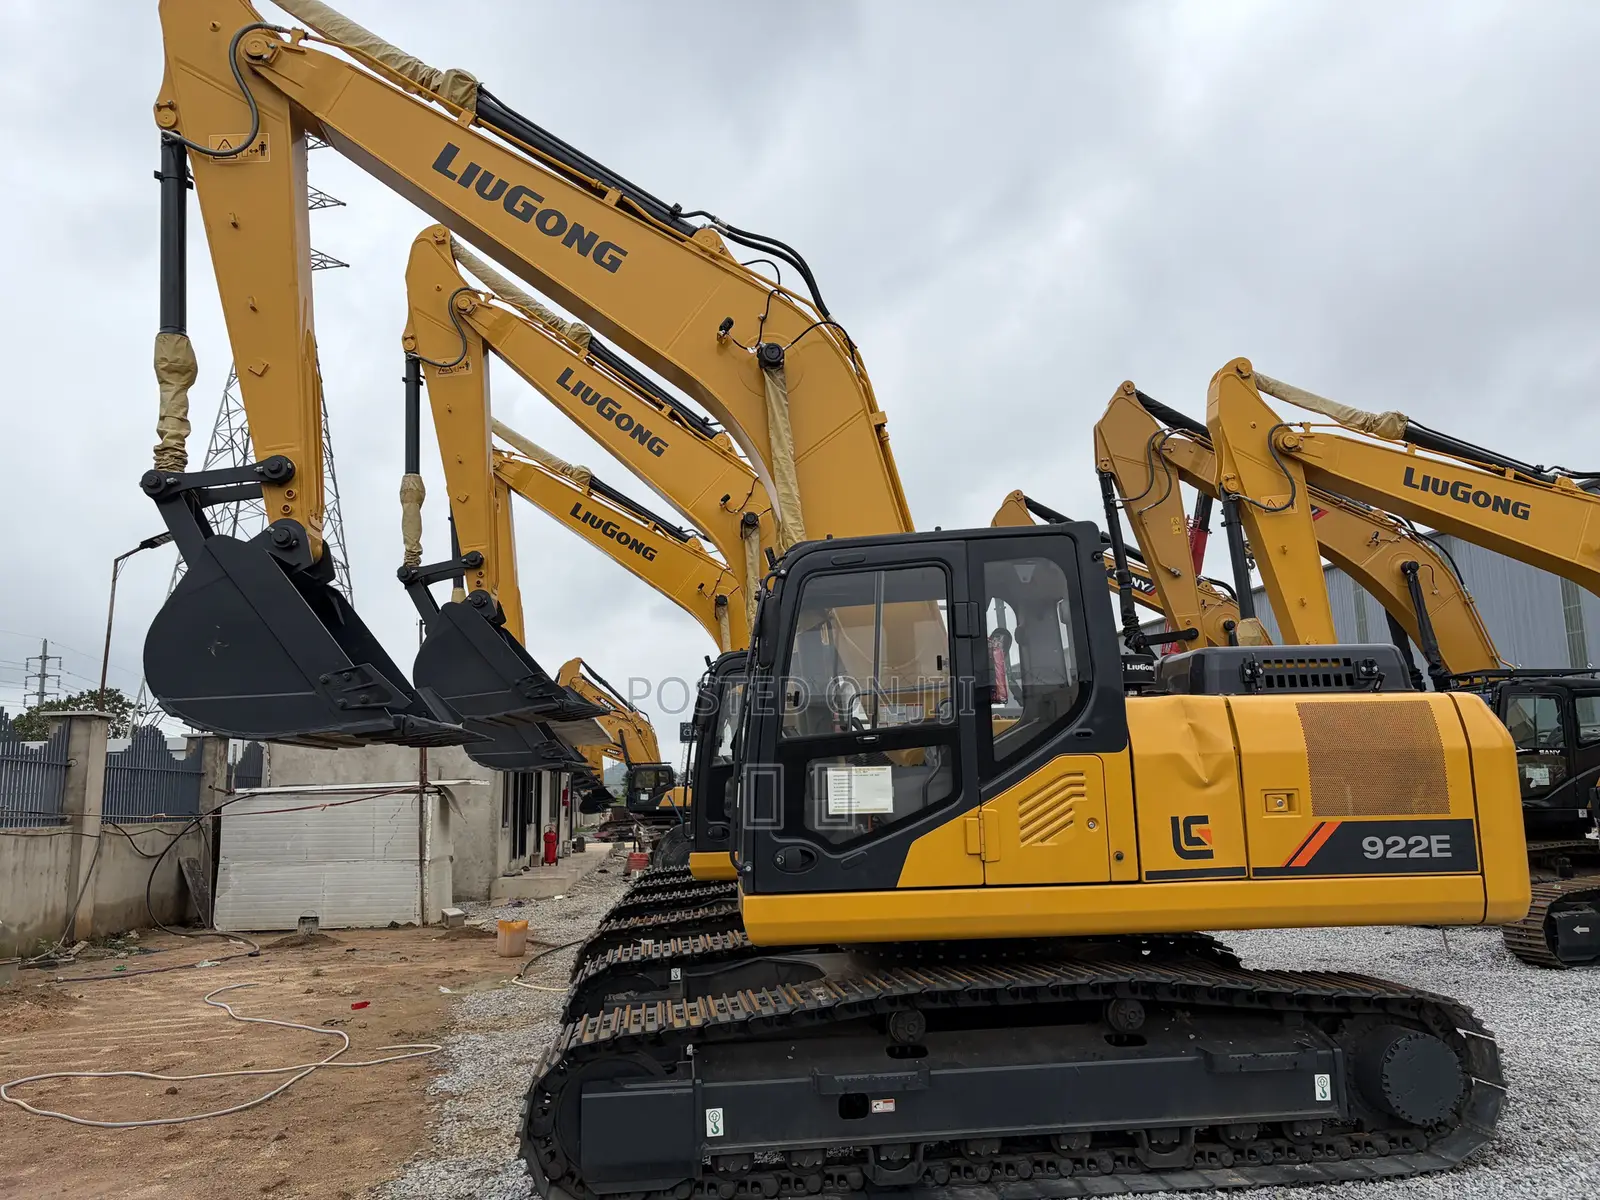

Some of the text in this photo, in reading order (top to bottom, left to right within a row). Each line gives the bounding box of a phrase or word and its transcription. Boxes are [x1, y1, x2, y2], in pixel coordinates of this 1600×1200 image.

[431, 141, 628, 274] LIUGONG
[555, 366, 669, 458] LIUGONG
[1402, 466, 1531, 521] LIUGONG
[569, 501, 658, 562] LIUGONG
[1361, 834, 1453, 860] 922E
